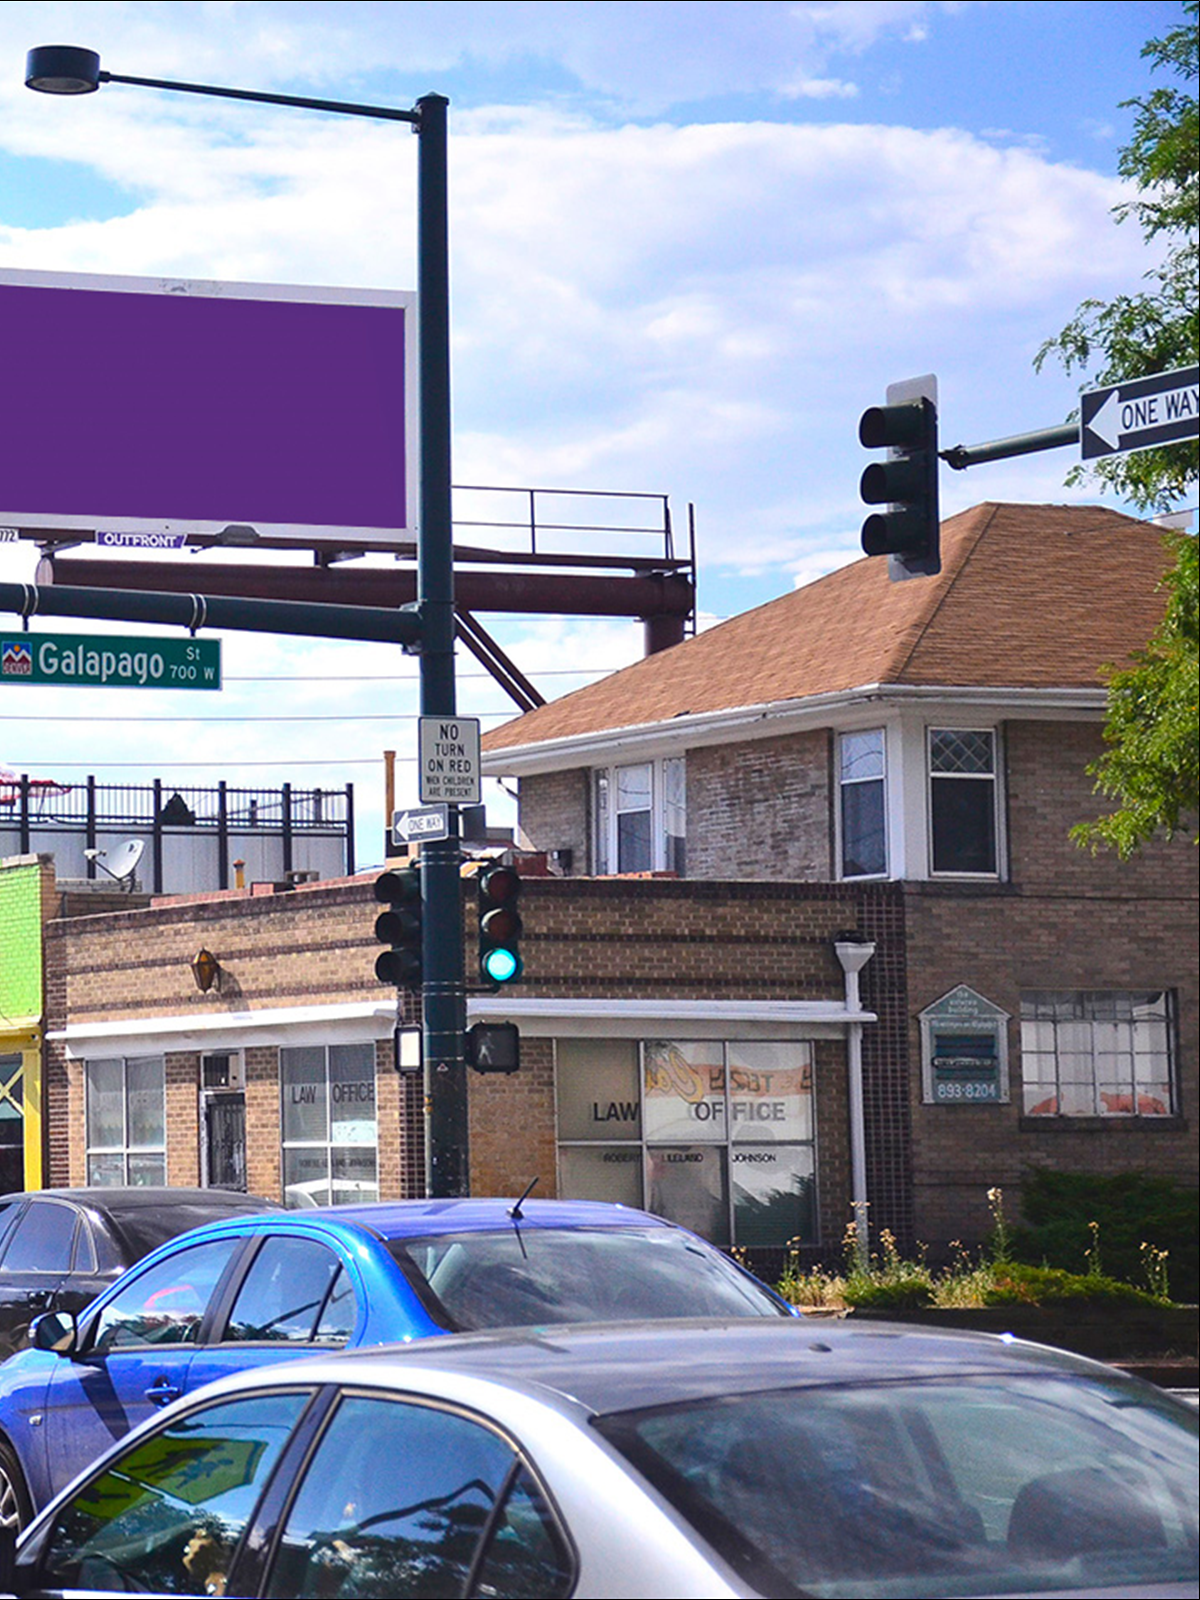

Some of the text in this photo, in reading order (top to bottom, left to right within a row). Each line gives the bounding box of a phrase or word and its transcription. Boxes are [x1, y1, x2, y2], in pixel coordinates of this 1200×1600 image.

[1121, 388, 1199, 430] ONE WAY
[103, 533, 177, 548] OUTFRONT
[186, 646, 200, 661] St
[39, 642, 164, 684] Galapago
[169, 665, 215, 681] 700 W
[439, 724, 459, 741] NO
[435, 743, 465, 757] TURN
[428, 759, 471, 773] ON RED
[426, 776, 475, 786] WHEN CHILDREN
[428, 787, 472, 798] ARE PRESENT
[408, 815, 441, 832] ONE WAY
[292, 1083, 375, 1105] LAW OFFICE
[593, 1101, 786, 1122] LAW OFFICE
[731, 1153, 776, 1163] JOHNSON
